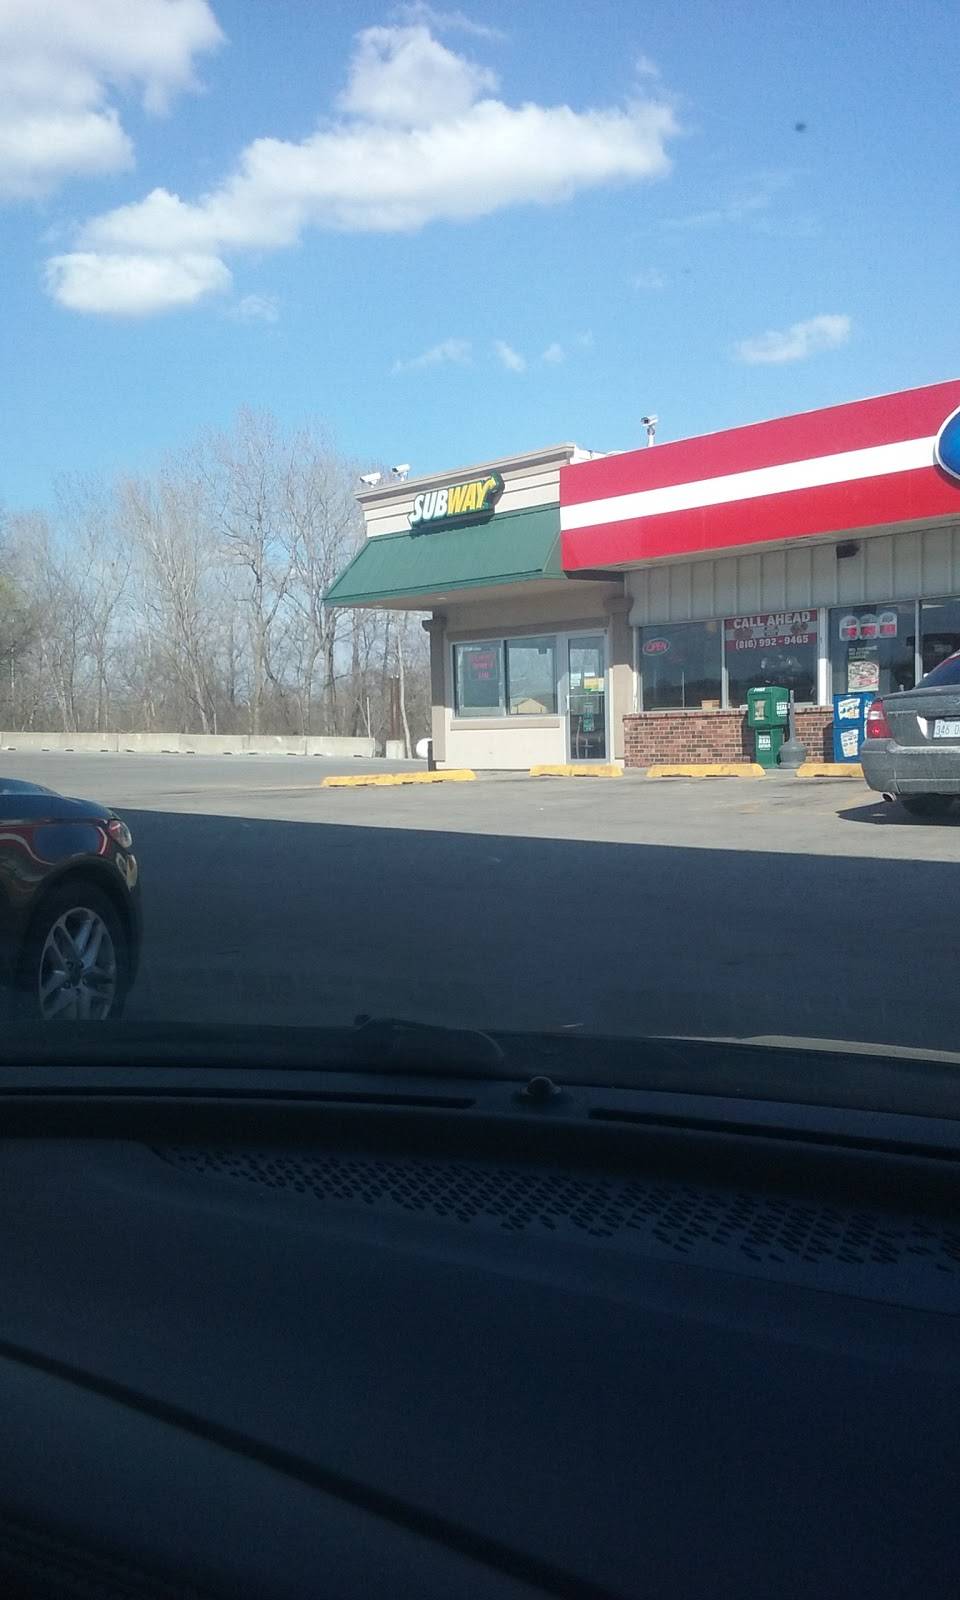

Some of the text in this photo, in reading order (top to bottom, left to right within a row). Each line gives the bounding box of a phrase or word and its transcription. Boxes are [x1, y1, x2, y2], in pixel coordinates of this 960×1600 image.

[409, 476, 498, 524] SUBWAY
[734, 611, 811, 629] CALL AHEAD
[759, 637, 777, 647] 992
[784, 634, 809, 645] 9465
